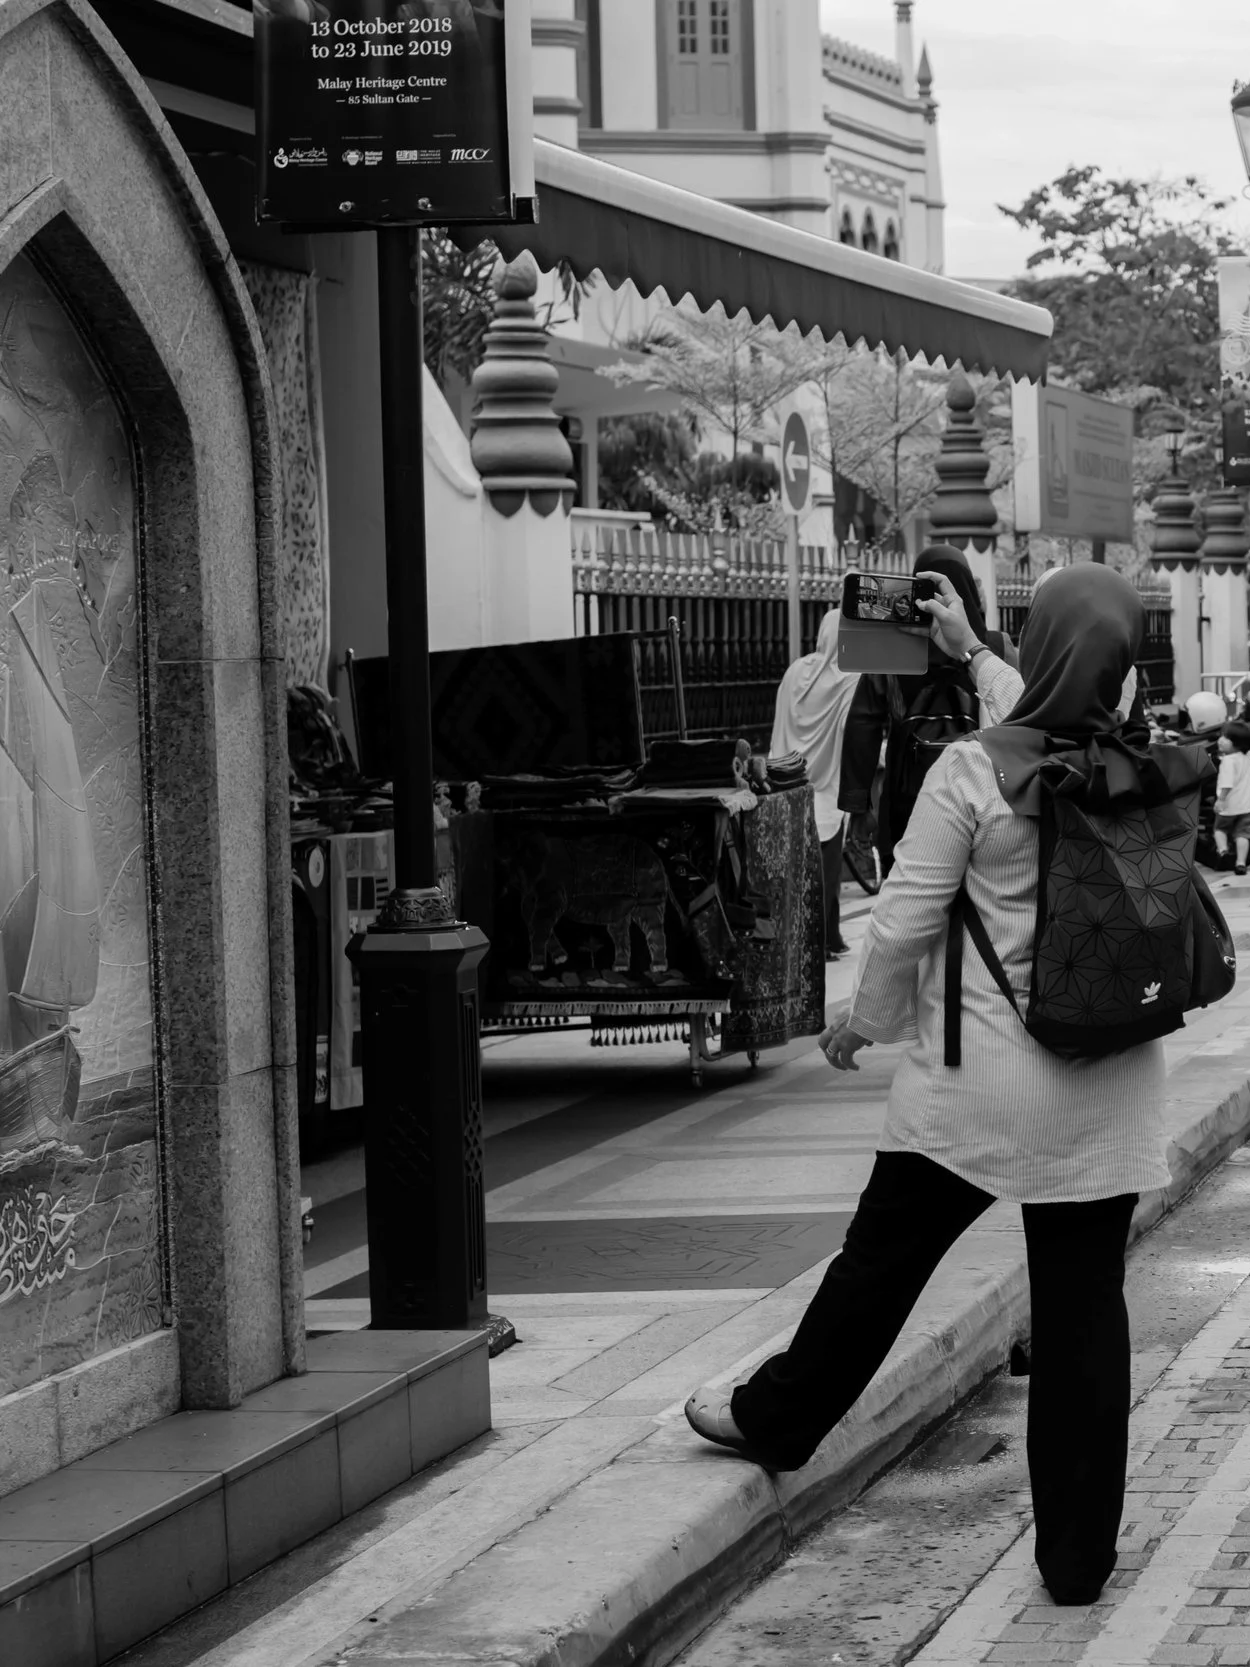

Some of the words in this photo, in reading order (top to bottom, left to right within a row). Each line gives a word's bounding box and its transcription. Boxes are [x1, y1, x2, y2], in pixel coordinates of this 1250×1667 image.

[310, 21, 330, 37] 13
[333, 18, 405, 36] October
[409, 17, 452, 34] 2018
[311, 44, 330, 58] to
[334, 43, 356, 58] 23
[360, 40, 404, 57] June
[408, 40, 452, 57] 2019
[317, 78, 353, 91] Malay
[355, 77, 405, 91] Heritage
[407, 76, 447, 87] Centre
[348, 95, 360, 104] 85
[362, 94, 394, 104] Sultan
[396, 94, 419, 104] Gate
